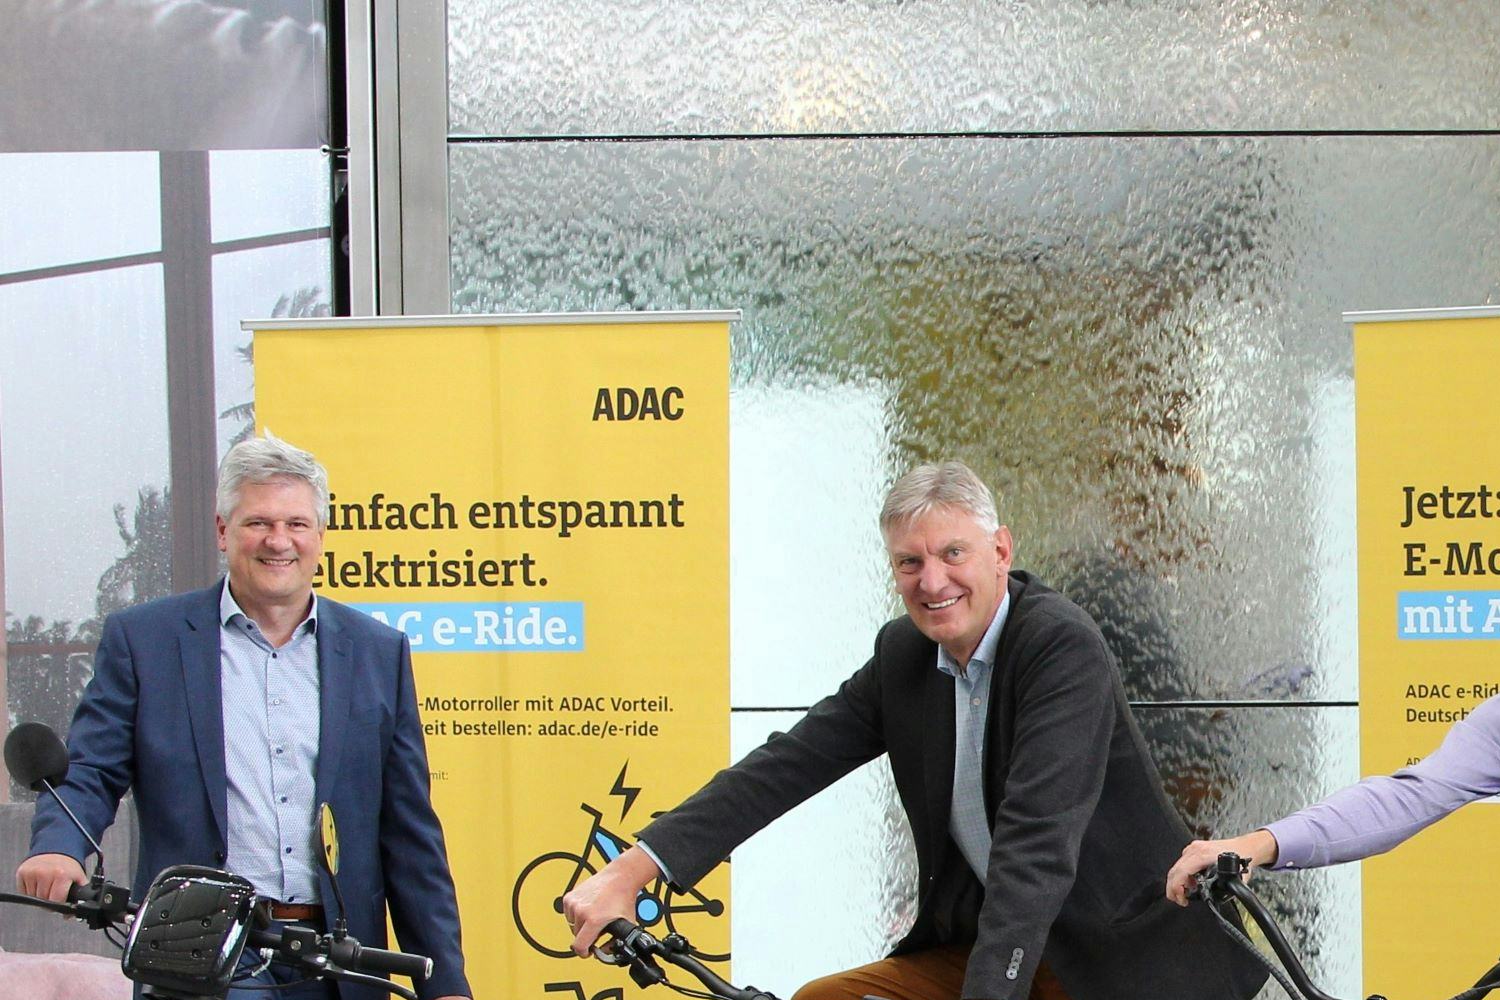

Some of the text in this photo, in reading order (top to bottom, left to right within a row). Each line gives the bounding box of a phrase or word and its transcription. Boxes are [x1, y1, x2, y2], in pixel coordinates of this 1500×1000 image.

[592, 386, 685, 421] ADAC
[325, 492, 685, 537] infach entspannt
[432, 606, 577, 646] e-Ride.
[1403, 595, 1474, 634] mit
[418, 695, 674, 712] -Motorroller mit ADAC Vorteil.
[1405, 684, 1451, 699] ADAC
[452, 720, 532, 736] bestellen:
[538, 720, 660, 739] adac.de/e-ride
